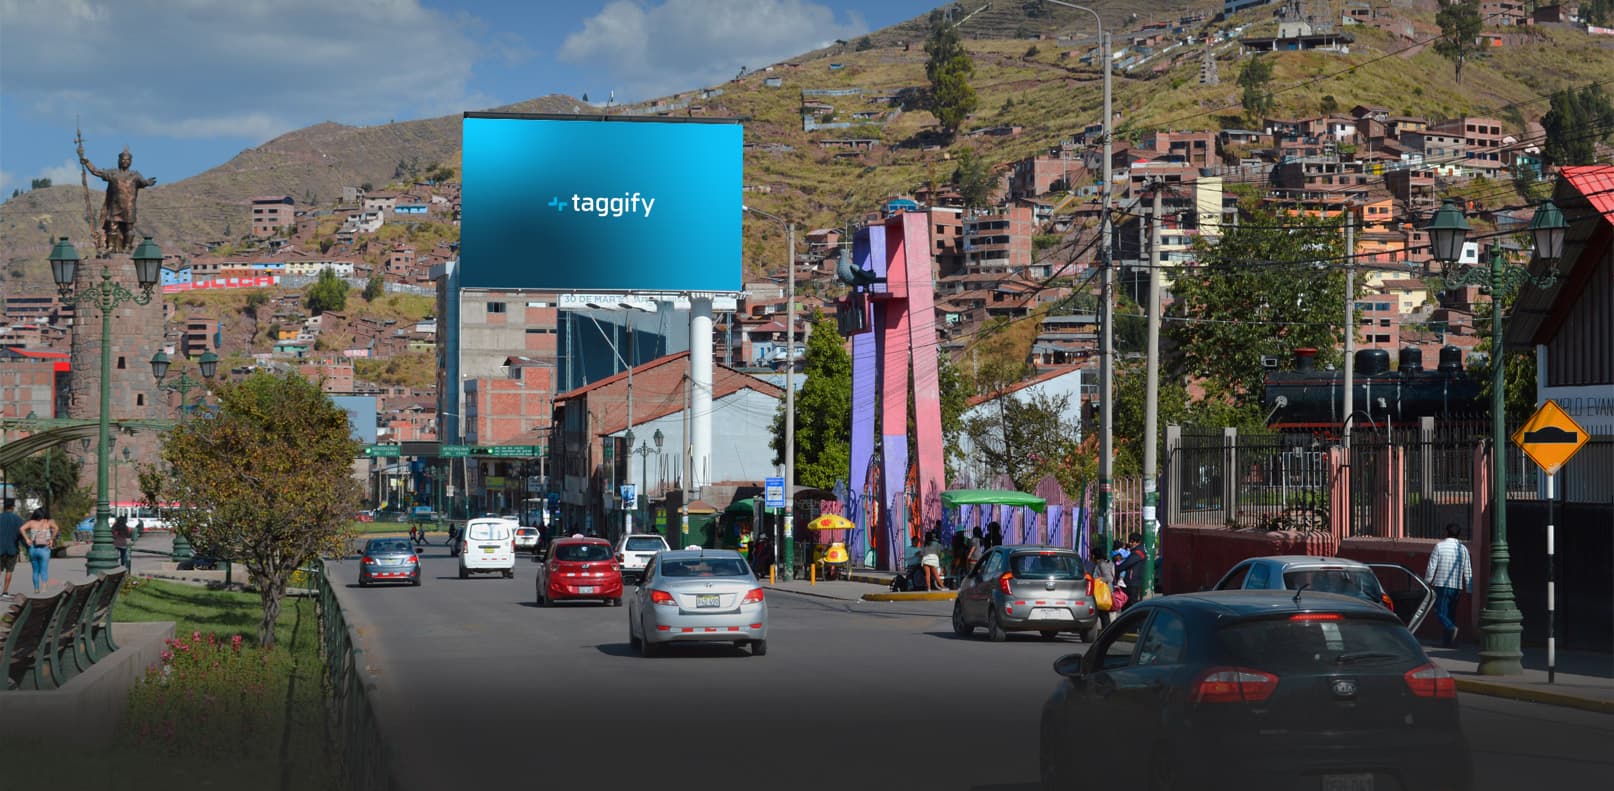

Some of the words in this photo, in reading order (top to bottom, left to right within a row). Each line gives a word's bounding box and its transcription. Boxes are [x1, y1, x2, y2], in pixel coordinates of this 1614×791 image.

[572, 192, 655, 217] taggify
[564, 295, 577, 303] 30
[579, 295, 592, 303] DE
